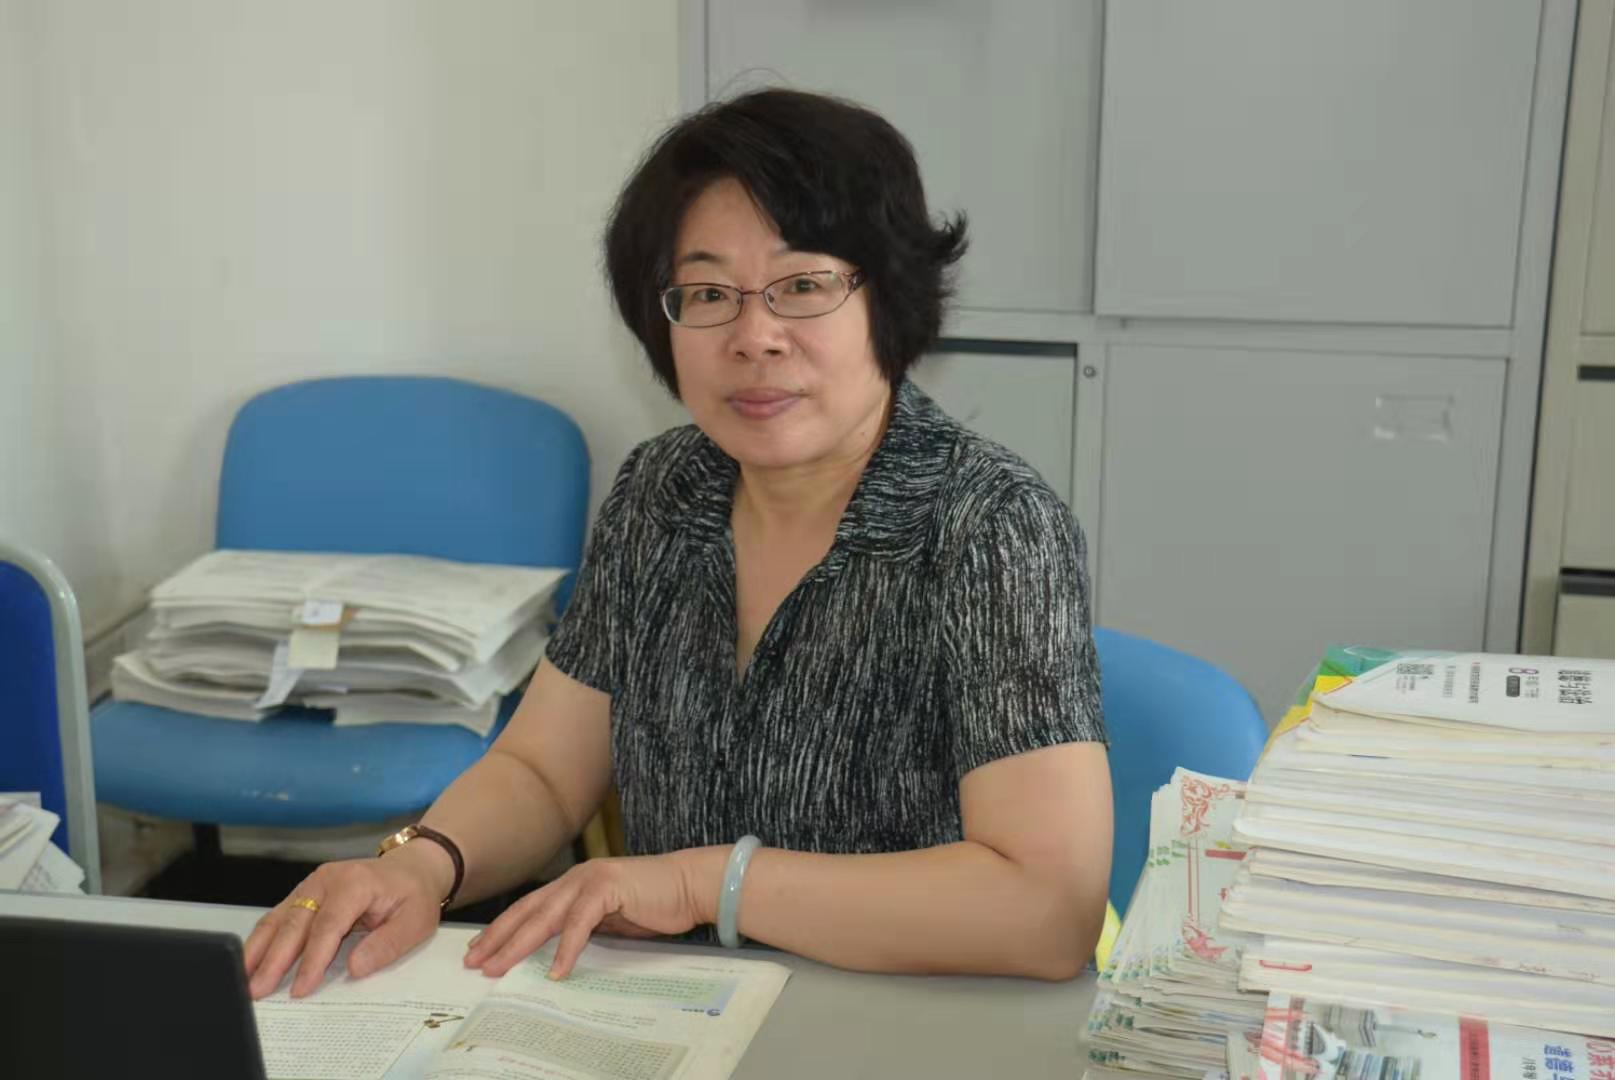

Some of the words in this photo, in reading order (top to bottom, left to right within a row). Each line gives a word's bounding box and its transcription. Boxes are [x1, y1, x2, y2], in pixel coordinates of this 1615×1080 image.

[1508, 666, 1539, 675] 8
[1558, 669, 1593, 704] 道德与法治
